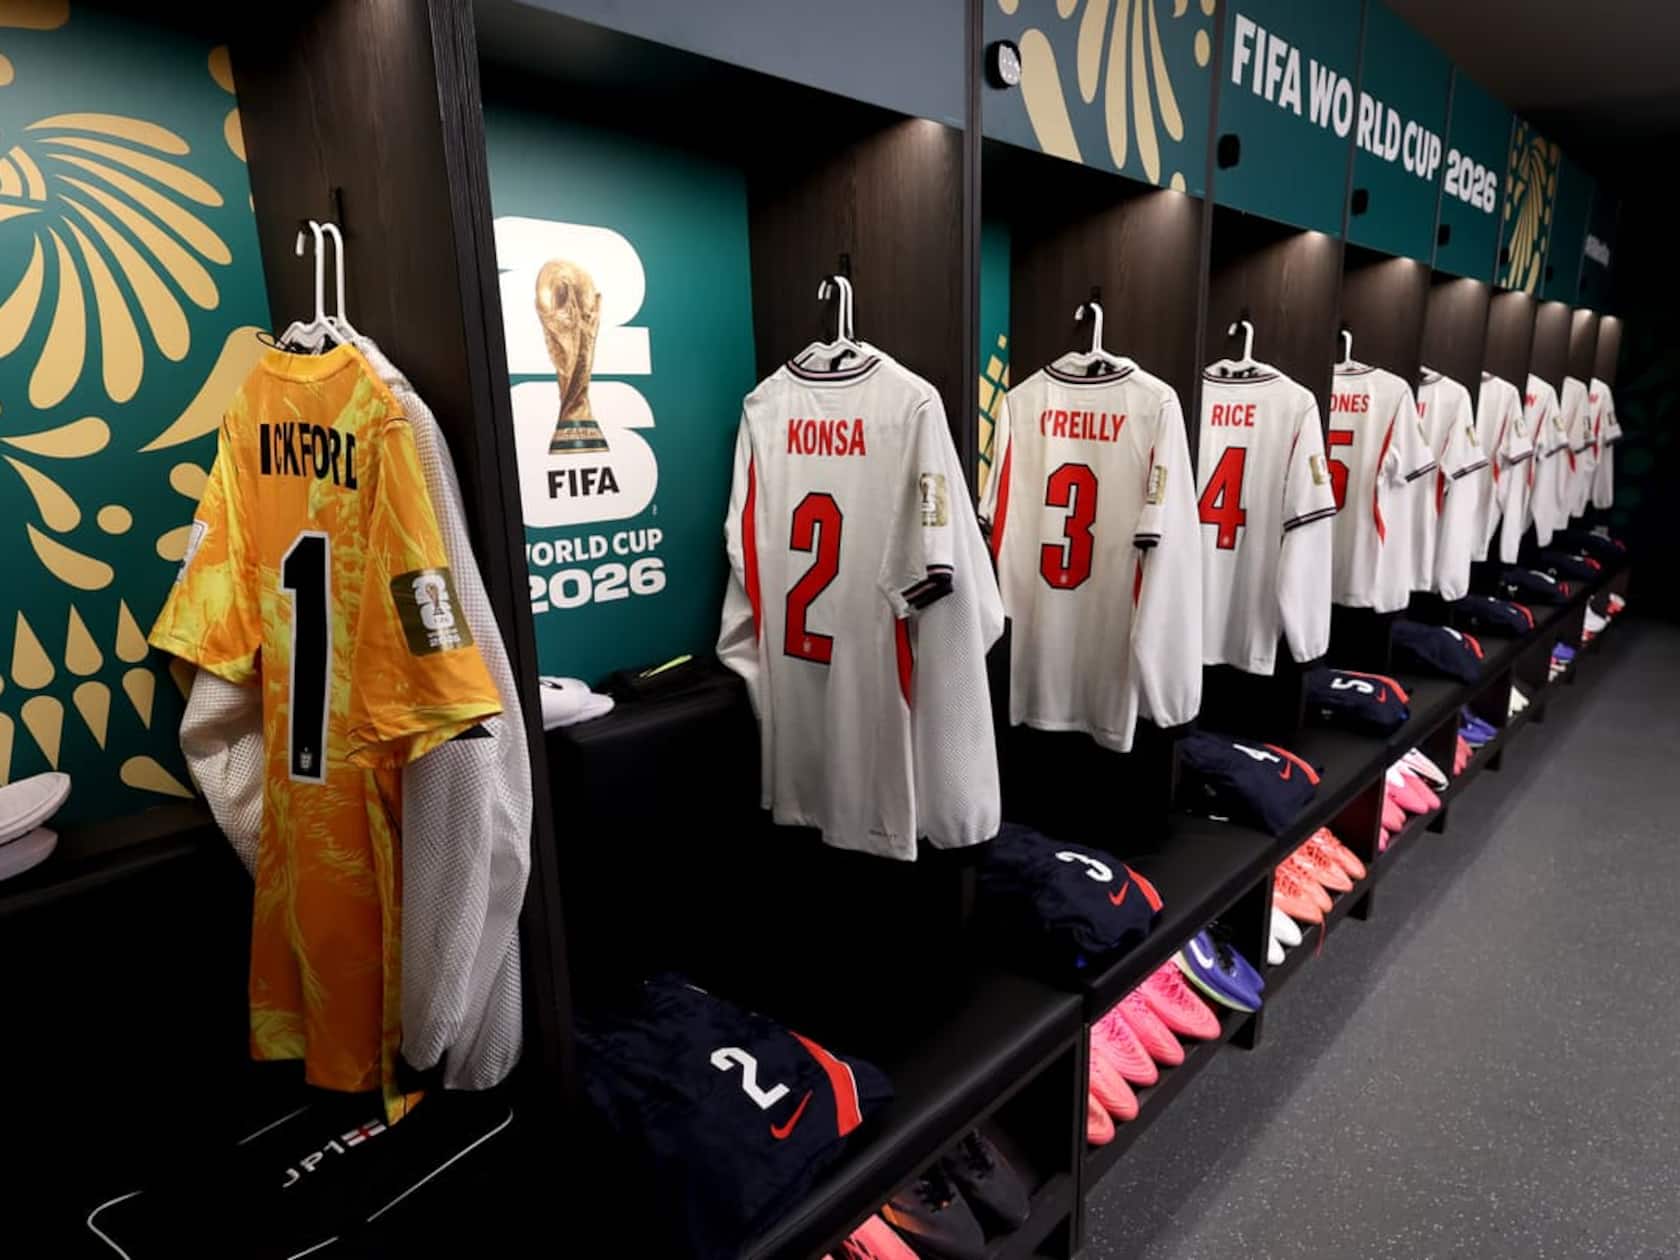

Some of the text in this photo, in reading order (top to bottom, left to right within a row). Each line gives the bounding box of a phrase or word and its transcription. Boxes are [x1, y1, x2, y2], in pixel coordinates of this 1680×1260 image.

[1231, 13, 1302, 115] FIFA
[1403, 120, 1442, 182] CUP
[1444, 147, 1498, 214] 2026
[1211, 403, 1257, 428] RICE
[1329, 394, 1370, 413] ONES
[260, 421, 358, 491] ICKFORD
[787, 418, 866, 457] KONSA
[547, 466, 620, 499] FIFA
[1197, 446, 1248, 551] 4
[1326, 429, 1354, 513] 5
[612, 527, 663, 556] CUP
[1039, 462, 1098, 590] 3
[528, 556, 667, 615] 2026
[783, 491, 843, 666] 2
[280, 529, 333, 785] 1
[1330, 677, 1374, 694] 5
[1055, 850, 1114, 882] 3
[710, 1047, 791, 1111] 2
[282, 1139, 345, 1188] JP1
